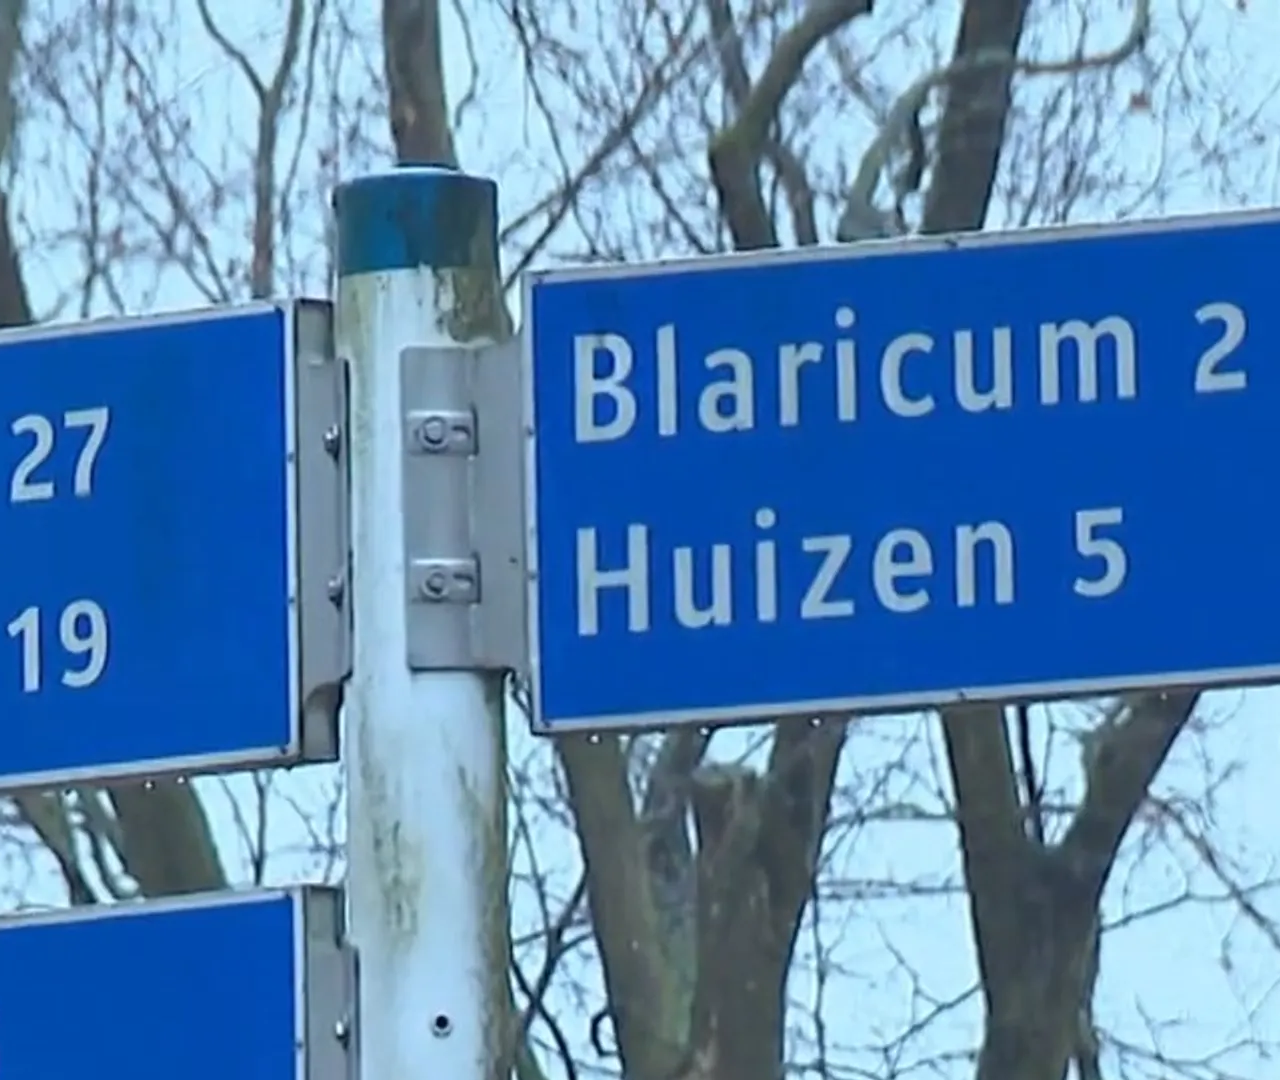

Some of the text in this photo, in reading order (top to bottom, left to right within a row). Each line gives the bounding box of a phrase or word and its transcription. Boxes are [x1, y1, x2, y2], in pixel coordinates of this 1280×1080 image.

[573, 302, 1247, 443] Blaricum 2
[10, 407, 110, 503] 27
[577, 507, 1127, 636] Huizen 5
[8, 599, 109, 694] 19
